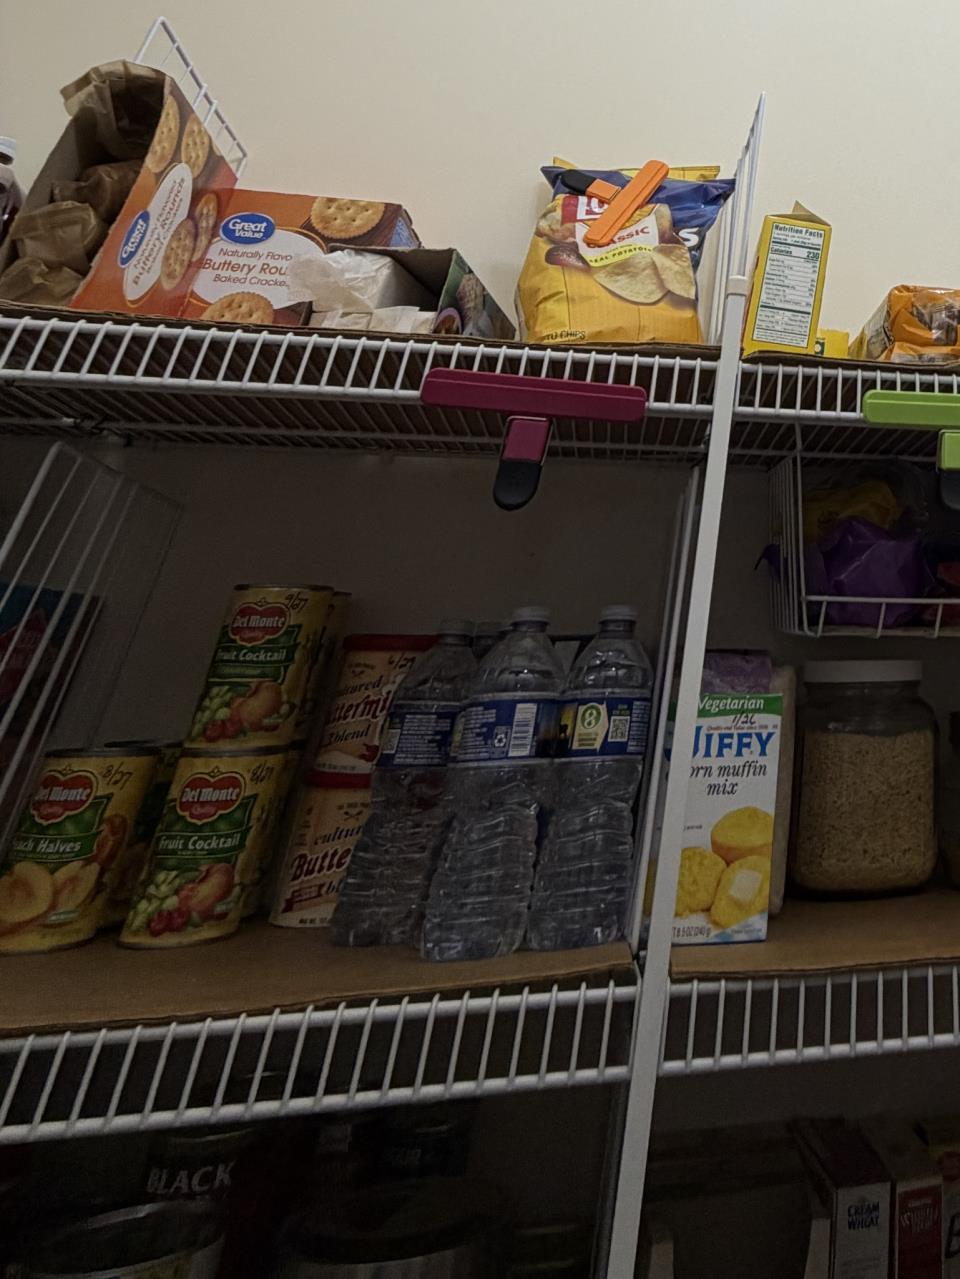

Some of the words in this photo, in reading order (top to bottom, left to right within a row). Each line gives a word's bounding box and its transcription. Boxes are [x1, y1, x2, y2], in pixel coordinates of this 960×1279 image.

[228, 219, 268, 233] Great
[774, 223, 803, 235] Nutrition
[804, 228, 822, 238] Facts
[234, 229, 264, 239] Value
[587, 226, 651, 248] ASSIC
[218, 248, 263, 261] Naturally
[266, 251, 293, 262] Flavo
[203, 258, 257, 276] Buttery
[259, 263, 288, 276] Rou
[213, 273, 247, 285] Baked
[249, 276, 289, 288] Cracke
[560, 330, 586, 340] CHIPS
[249, 615, 285, 628] Monte
[238, 648, 287, 661] Cocktail
[698, 695, 764, 713] Vegetarian
[717, 760, 767, 777] muffin
[49, 786, 92, 801] Monte
[181, 787, 200, 802] Del
[199, 787, 240, 802] Monte
[707, 778, 738, 796] mix
[36, 838, 81, 852] Halves
[188, 833, 240, 850] Cocktail
[289, 847, 352, 884] Butte
[146, 1159, 238, 1196] BLACK
